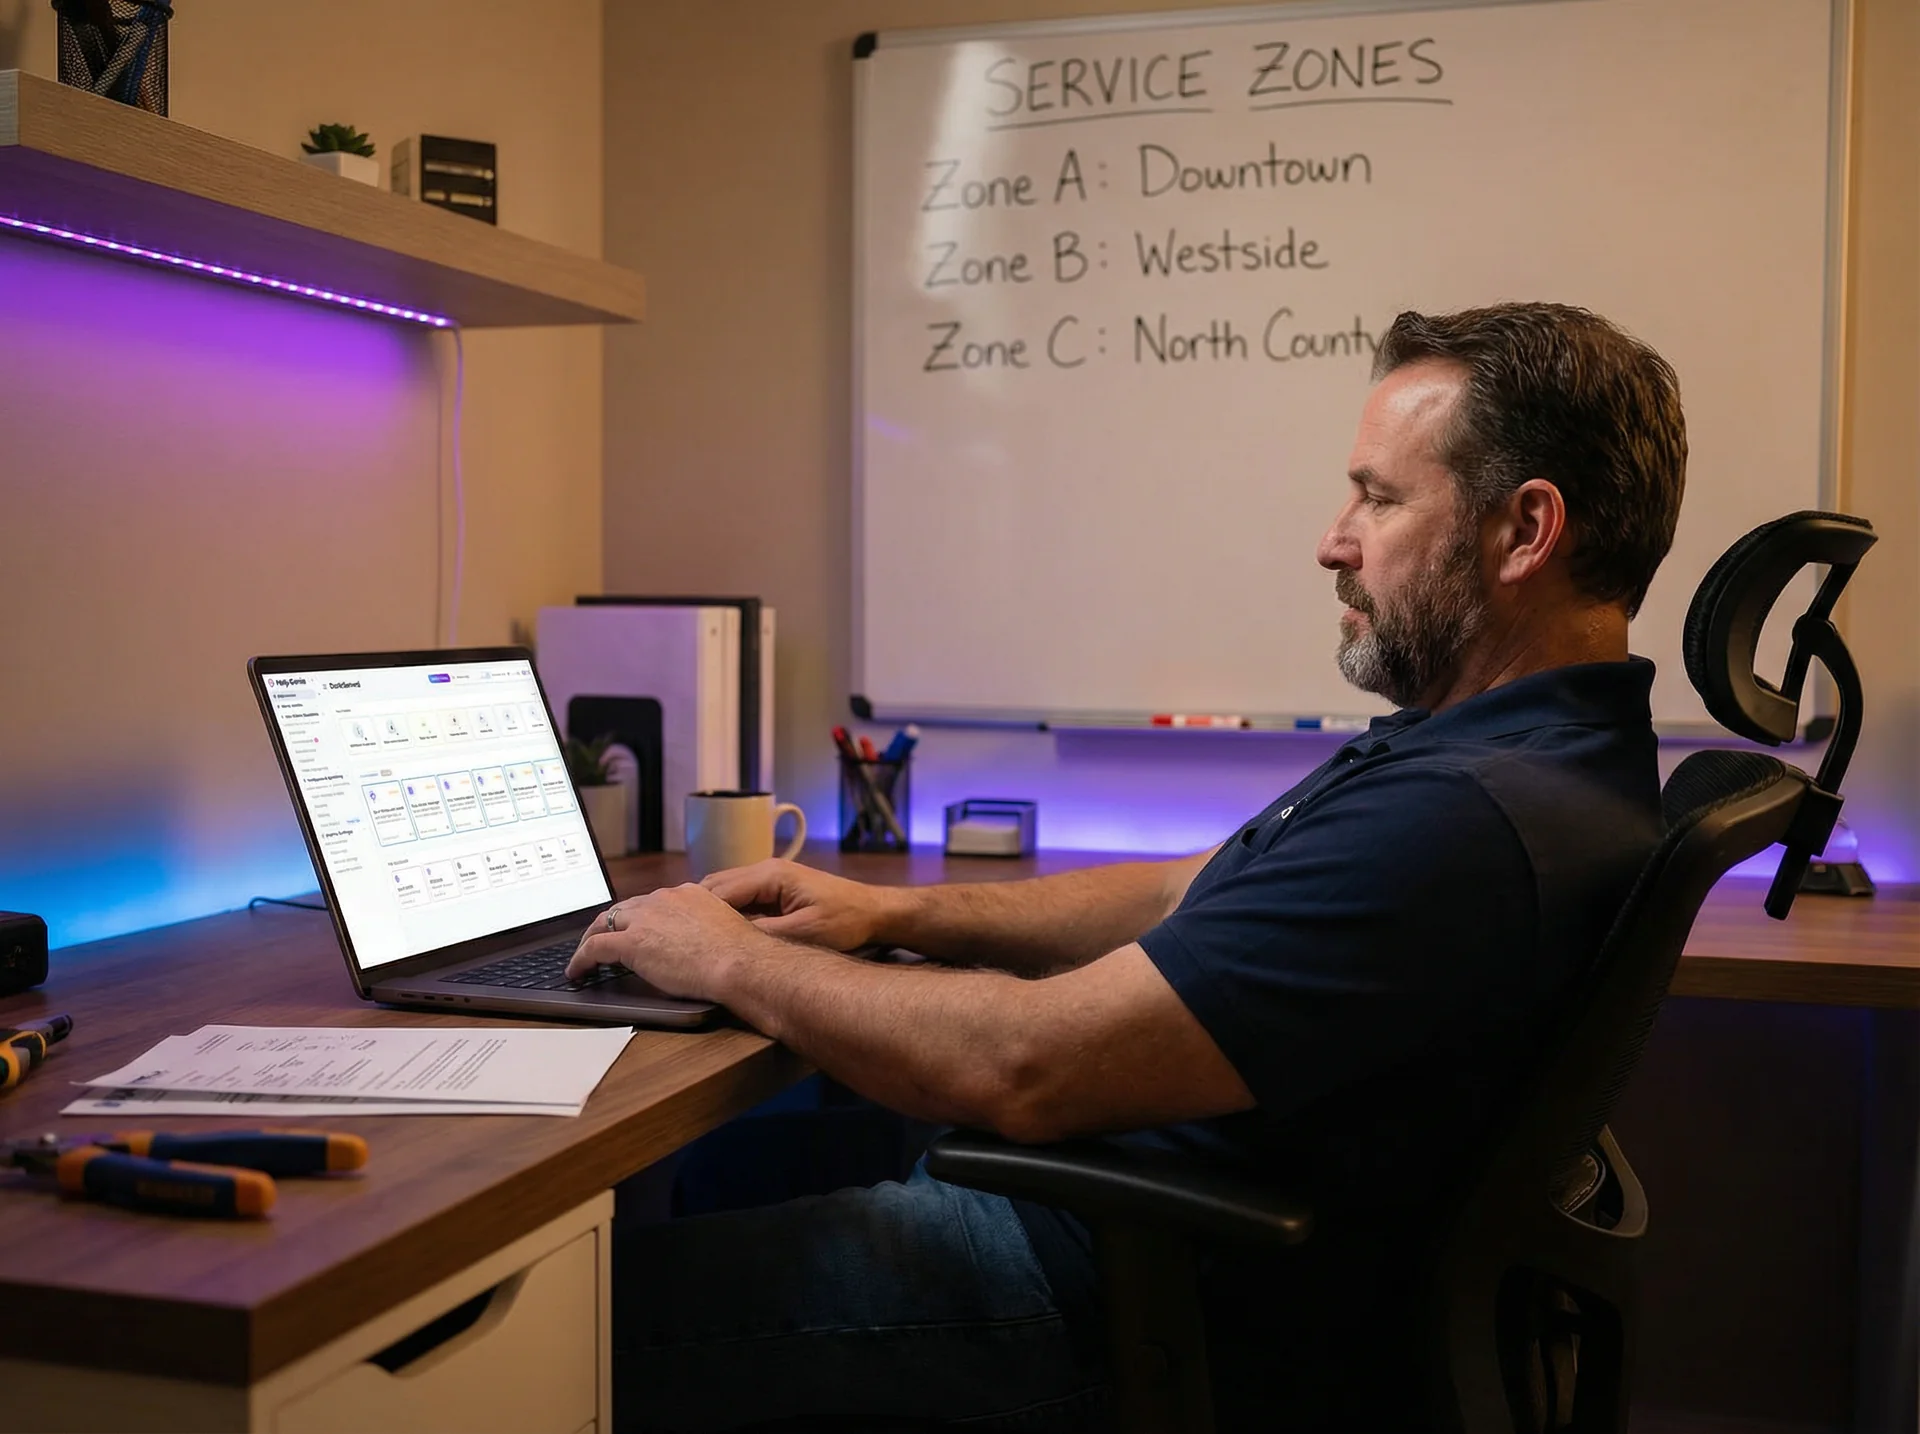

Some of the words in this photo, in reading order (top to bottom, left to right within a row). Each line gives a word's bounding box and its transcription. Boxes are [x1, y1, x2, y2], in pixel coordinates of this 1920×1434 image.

[984, 49, 1213, 117] SERVICE
[1248, 37, 1444, 97] ZONES
[921, 158, 1037, 212] Zone
[1138, 141, 1371, 197] Downtown
[924, 240, 1033, 288] Zone
[1135, 226, 1330, 277] Westside
[923, 320, 1031, 373] Zone
[1134, 312, 1249, 364] North
